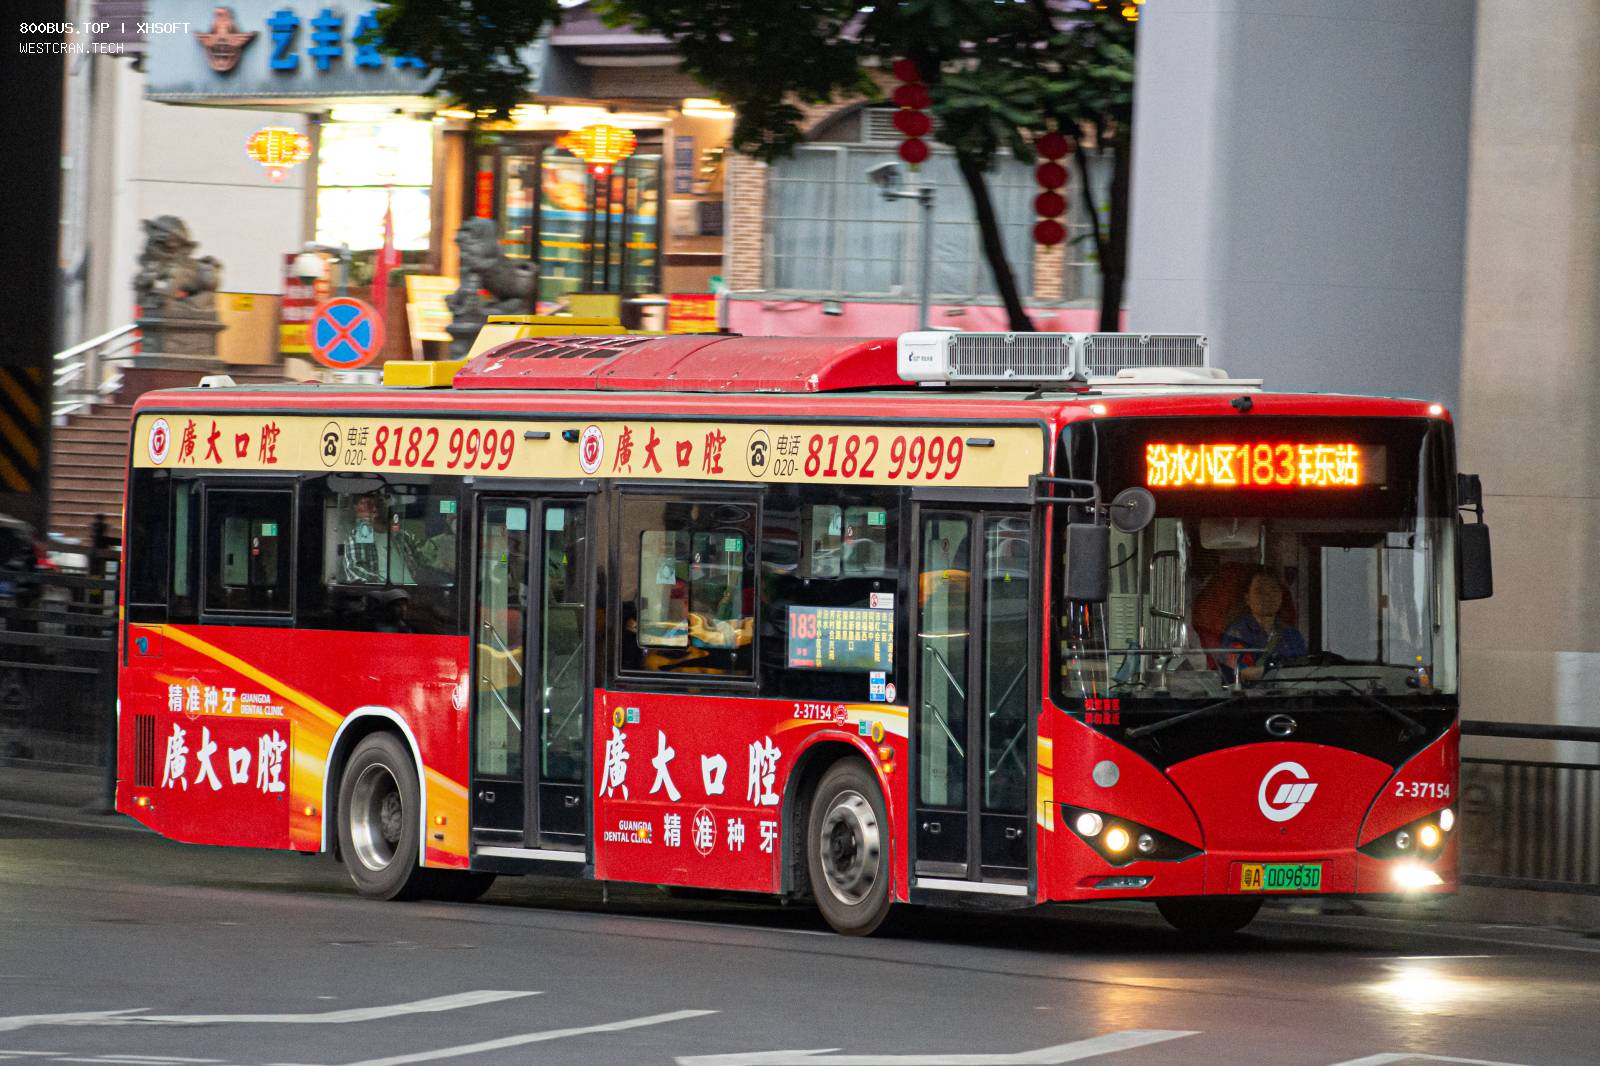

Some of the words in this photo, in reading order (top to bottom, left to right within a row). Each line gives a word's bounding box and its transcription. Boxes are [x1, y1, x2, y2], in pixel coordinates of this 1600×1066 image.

[177, 418, 281, 465] 廣大口腔
[347, 426, 369, 446] 电话
[776, 434, 801, 456] 电话
[344, 449, 367, 466] 020-
[371, 425, 439, 467] 8182
[447, 427, 515, 470] 9999
[612, 425, 727, 475] 廣大口腔
[804, 433, 880, 478] 8182
[887, 435, 964, 480] 9999
[773, 458, 799, 476] 020-
[789, 612, 817, 640] 183
[169, 684, 236, 714] 精准种牙
[240, 693, 271, 704] GUANGDA
[240, 705, 263, 715] DENTAL
[264, 706, 284, 716] CLINIC
[793, 703, 832, 720] 2-37154
[161, 722, 288, 795] 廣大口腔
[599, 726, 782, 807] 廣大口腔
[1395, 781, 1451, 799] 2-37154
[618, 820, 652, 831] GUANGDA
[663, 813, 778, 853] 精准种牙
[603, 831, 629, 843] DENTAL
